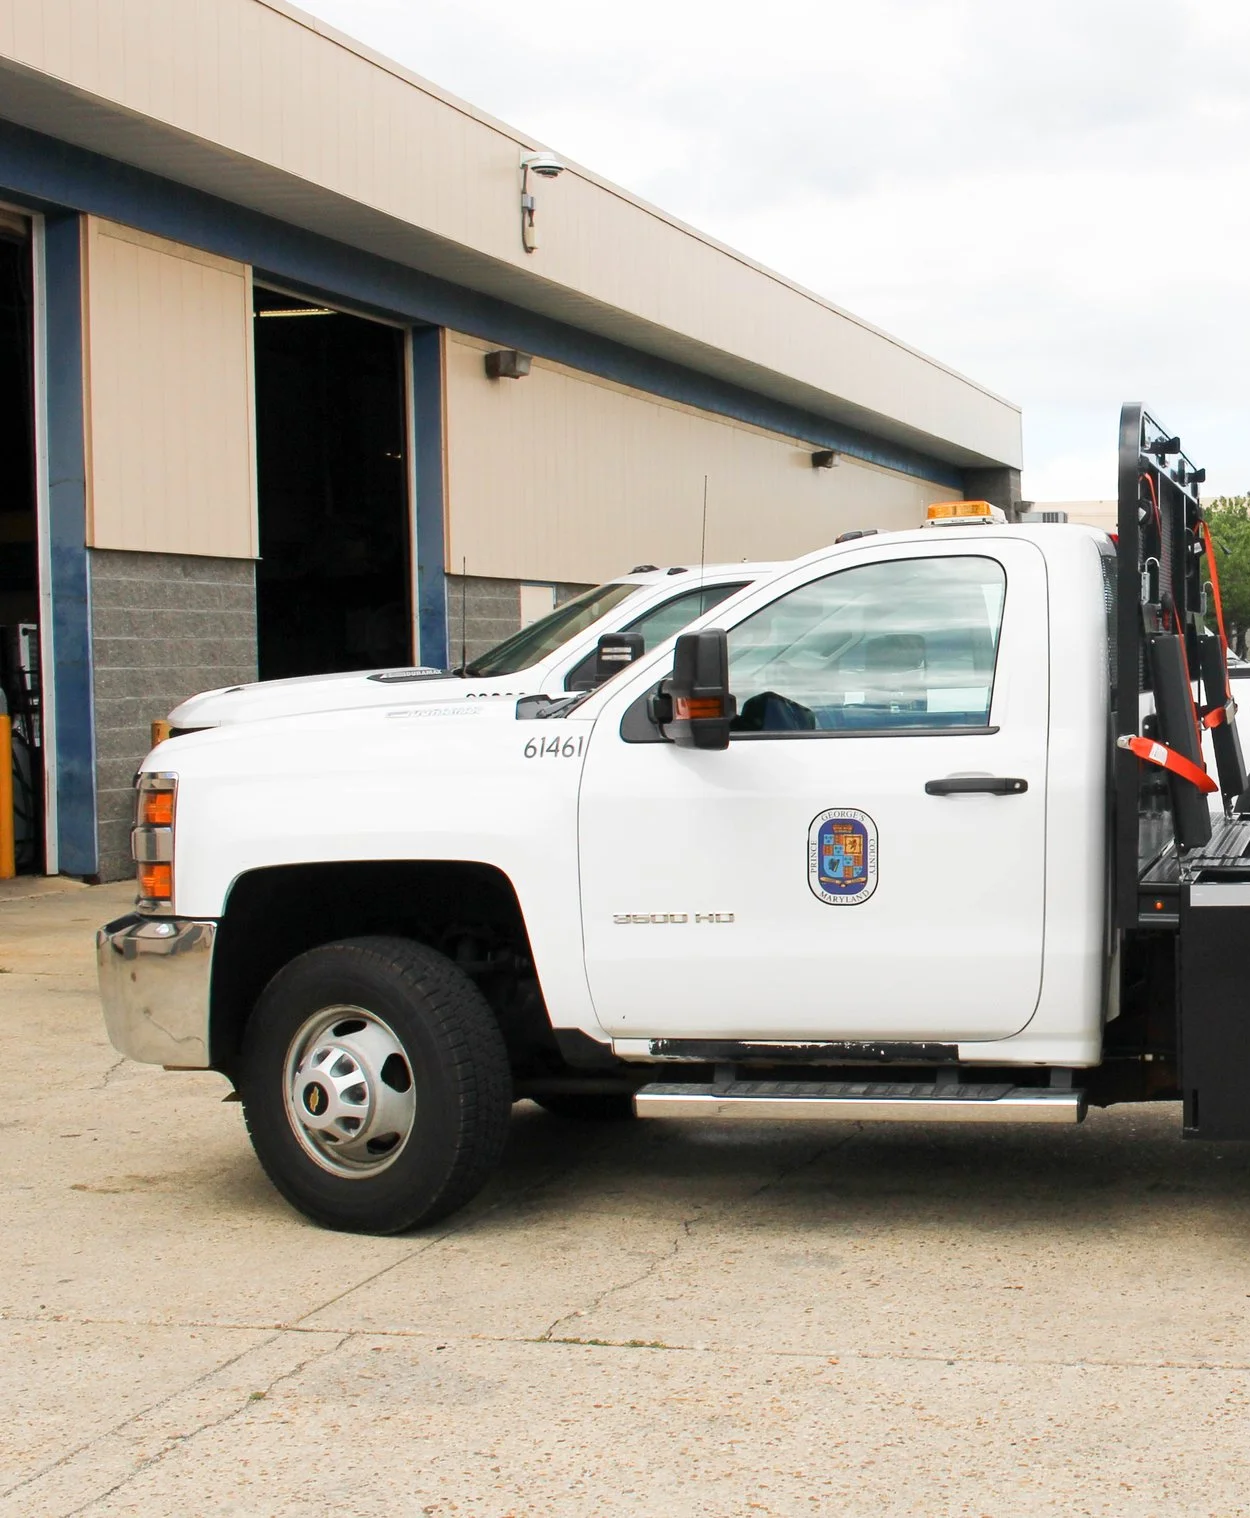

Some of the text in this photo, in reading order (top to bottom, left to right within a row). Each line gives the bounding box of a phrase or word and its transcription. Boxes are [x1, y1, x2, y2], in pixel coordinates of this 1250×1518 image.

[524, 735, 585, 759] 61461
[820, 810, 867, 822] GEORGE'S
[810, 840, 818, 874] PRINCE
[868, 838, 877, 875] COUNTY
[819, 889, 870, 904] MARYLAND
[613, 911, 736, 925] 3500 HD
